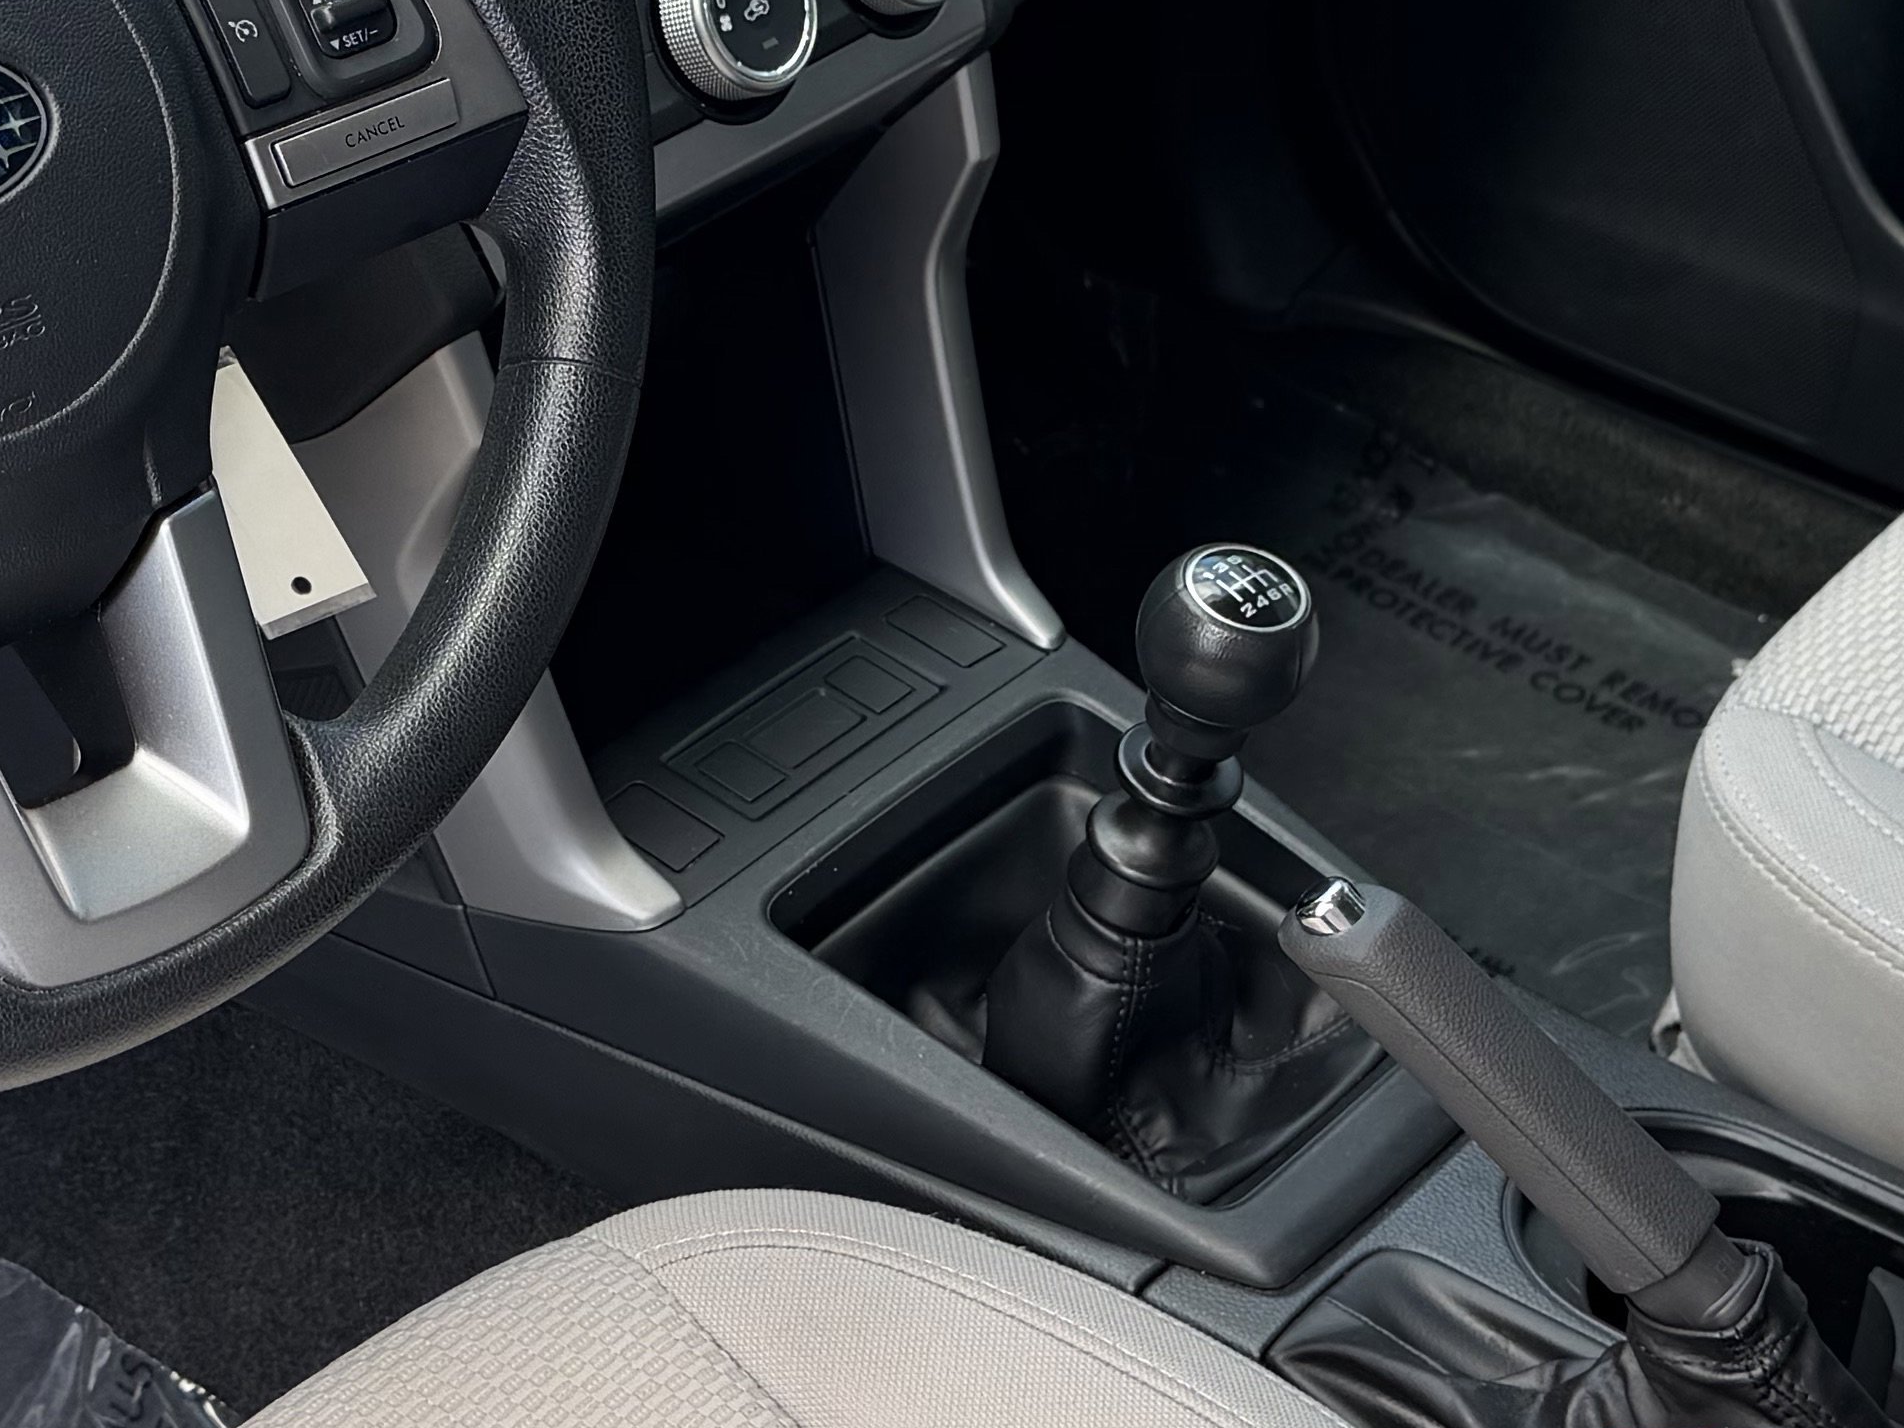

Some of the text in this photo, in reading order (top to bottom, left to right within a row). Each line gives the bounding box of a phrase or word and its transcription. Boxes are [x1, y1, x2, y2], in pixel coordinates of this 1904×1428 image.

[345, 115, 405, 149] CANCEL
[1240, 602, 1256, 618] 2
[1256, 593, 1271, 609] 4
[1279, 583, 1294, 596] R
[1357, 546, 1704, 730] DEALER MUST REMO
[1528, 670, 1647, 734] COVER
